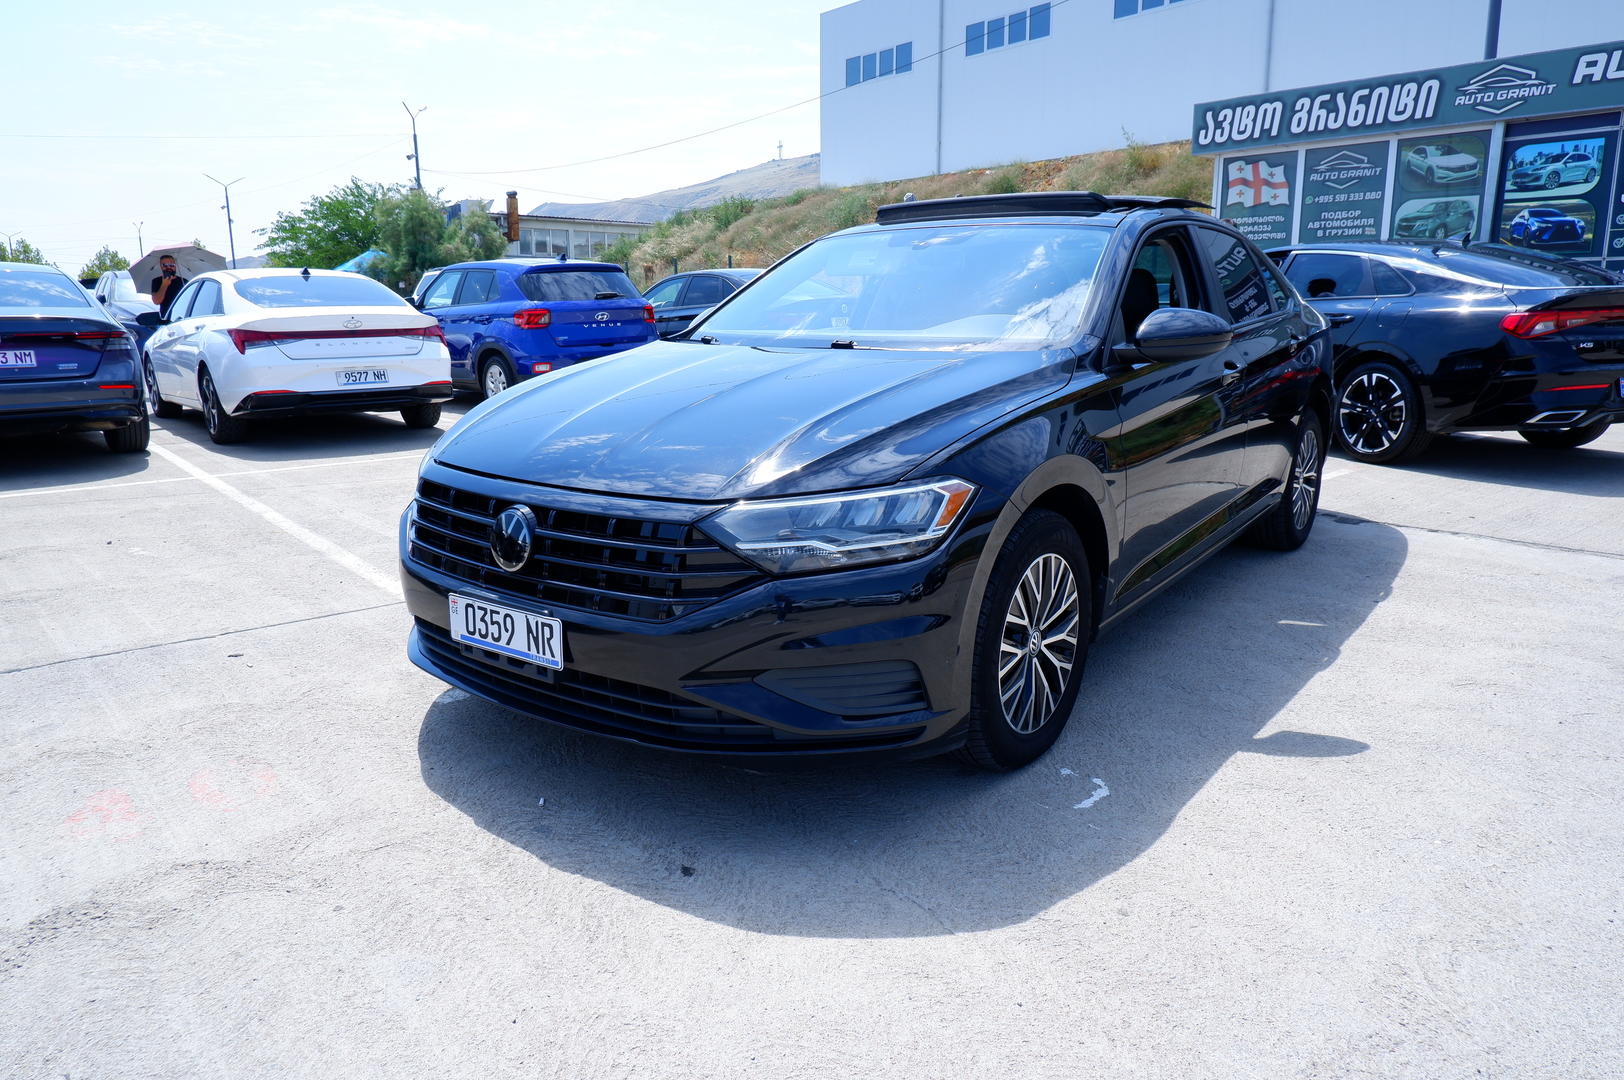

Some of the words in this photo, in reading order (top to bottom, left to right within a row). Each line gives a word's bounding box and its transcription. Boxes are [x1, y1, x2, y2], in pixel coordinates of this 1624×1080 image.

[1454, 92, 1495, 106] AUTO
[1496, 83, 1557, 101] GRANIT
[1199, 101, 1283, 145] ავტო
[1290, 79, 1440, 134] გრანიტი
[1310, 171, 1339, 182] AUTO
[1339, 167, 1383, 179] GRANIT
[1321, 209, 1362, 219] ПОДБОР
[1307, 217, 1374, 229] АВТОМОБИЛЯ
[1316, 228, 1324, 237] В
[1325, 227, 1363, 237] ГРУЗИИ
[14, 352, 33, 364] NM
[344, 371, 369, 383] 9577
[373, 370, 387, 380] NH
[464, 602, 515, 646] 0359
[525, 615, 555, 658] NR
